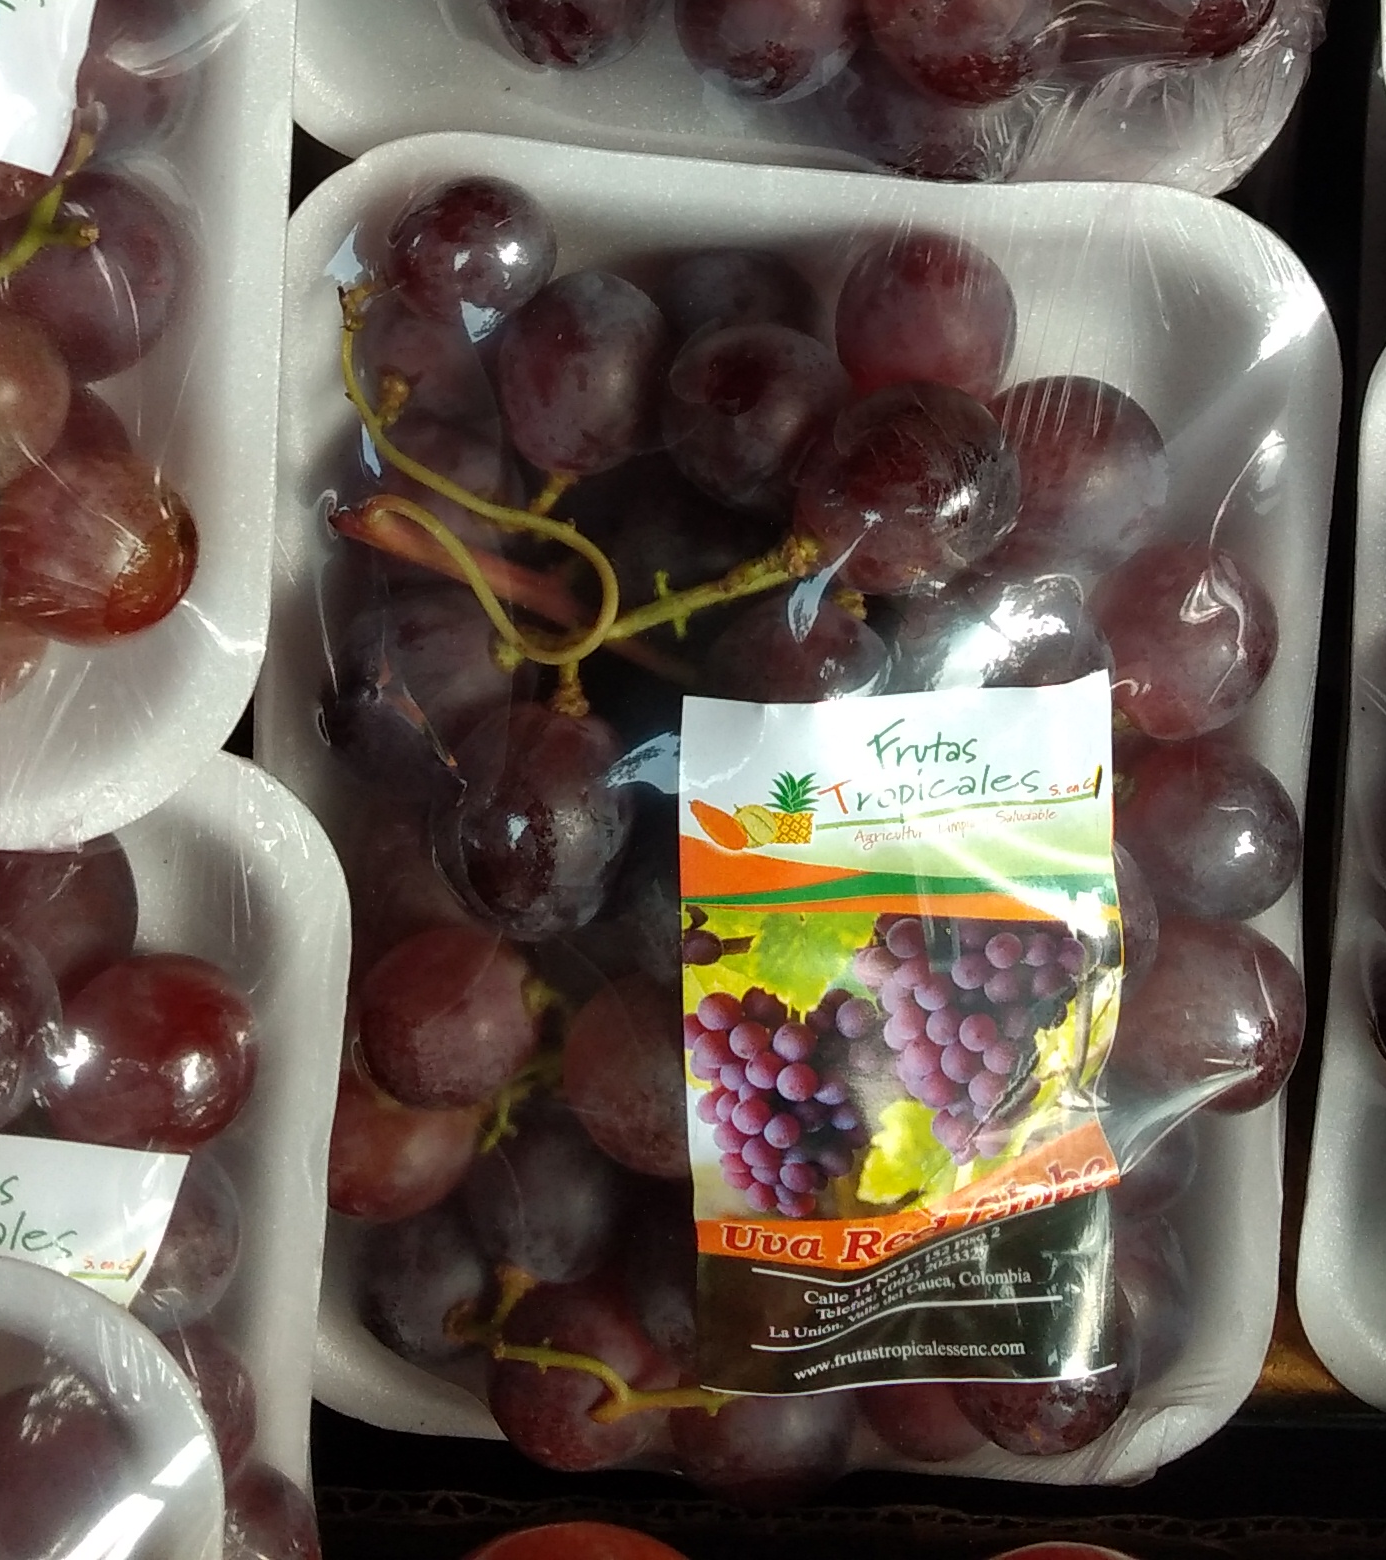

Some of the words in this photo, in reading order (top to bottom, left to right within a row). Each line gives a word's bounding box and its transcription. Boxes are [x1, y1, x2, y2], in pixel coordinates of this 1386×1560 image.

[866, 718, 977, 769] Frutas
[816, 764, 1040, 824] Tropicales
[854, 828, 923, 851] Agricultur
[996, 808, 1057, 824] Saludable
[720, 1224, 825, 1261] Uva
[803, 1290, 849, 1305] Calle
[854, 1281, 872, 1298] 14
[990, 1226, 1001, 1239] 2
[769, 1326, 790, 1339] La
[959, 1267, 1032, 1286] Colombia
[794, 1340, 1026, 1381] www.frutastropicalessenc.com
